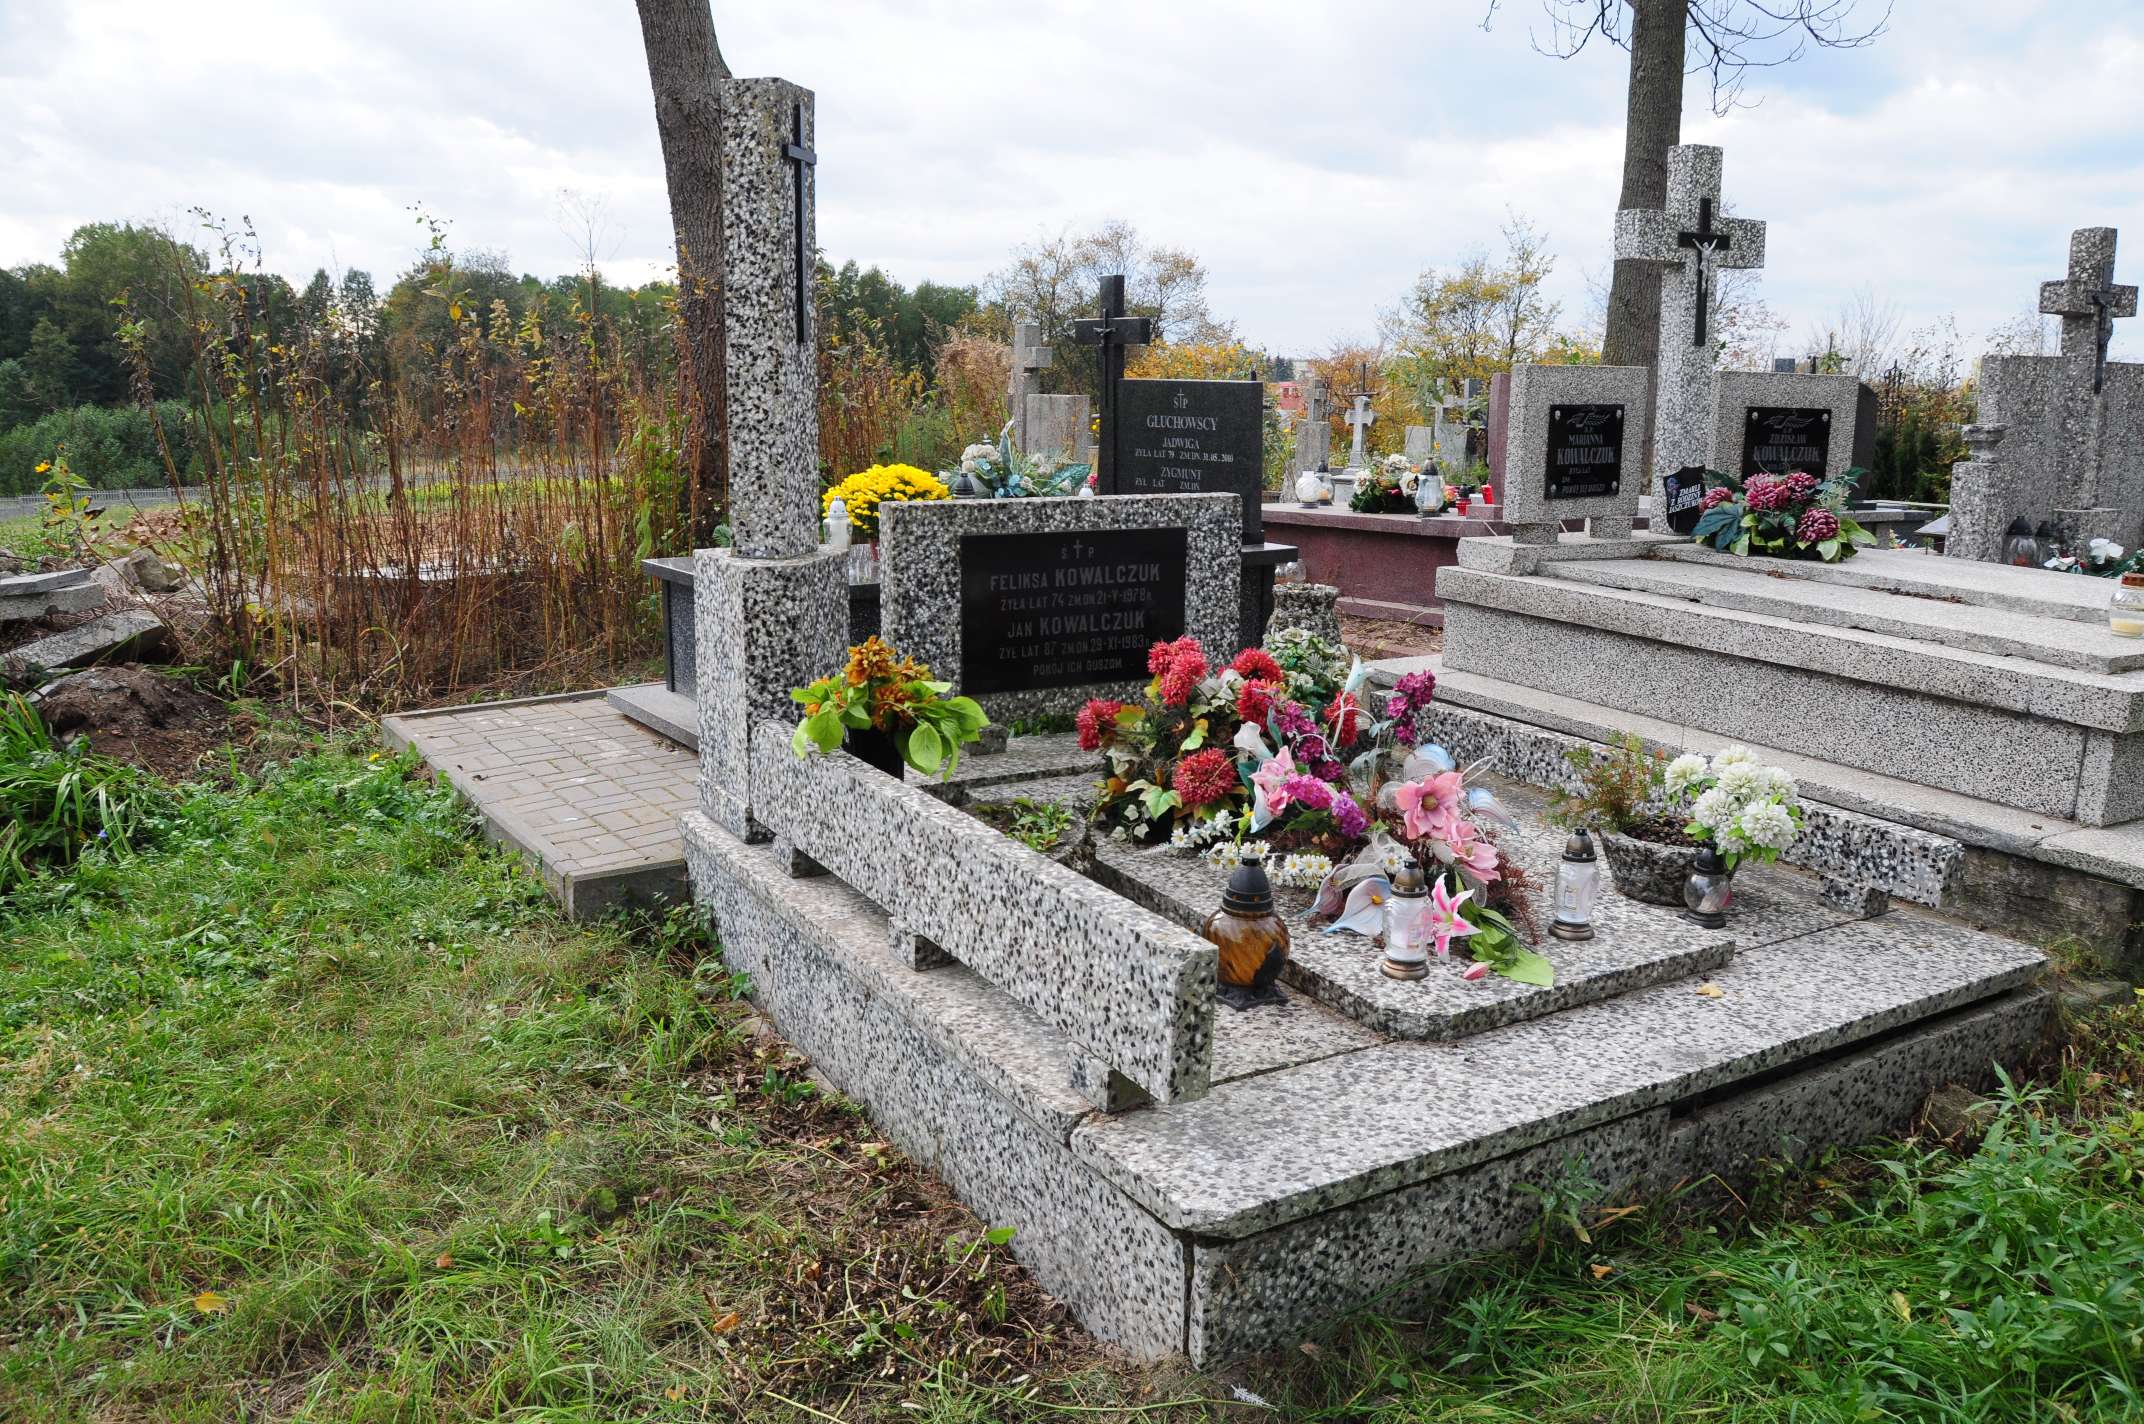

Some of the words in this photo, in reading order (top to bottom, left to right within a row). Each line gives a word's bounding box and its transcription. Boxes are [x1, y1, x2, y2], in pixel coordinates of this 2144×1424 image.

[1162, 437, 1200, 449] JADWIGA
[1557, 447, 1615, 465] KOWALCZUK
[1160, 466, 1201, 480] ZYGMUNT
[991, 572, 1048, 592] FELIKSA
[1055, 564, 1160, 588] KOWALCZUK
[1029, 596, 1048, 609] LAT
[1052, 593, 1064, 608] 74
[1007, 622, 1033, 639] JAN
[1039, 610, 1145, 636] KOWALCZUK
[1021, 645, 1040, 658] LAT
[1044, 641, 1056, 656] 87
